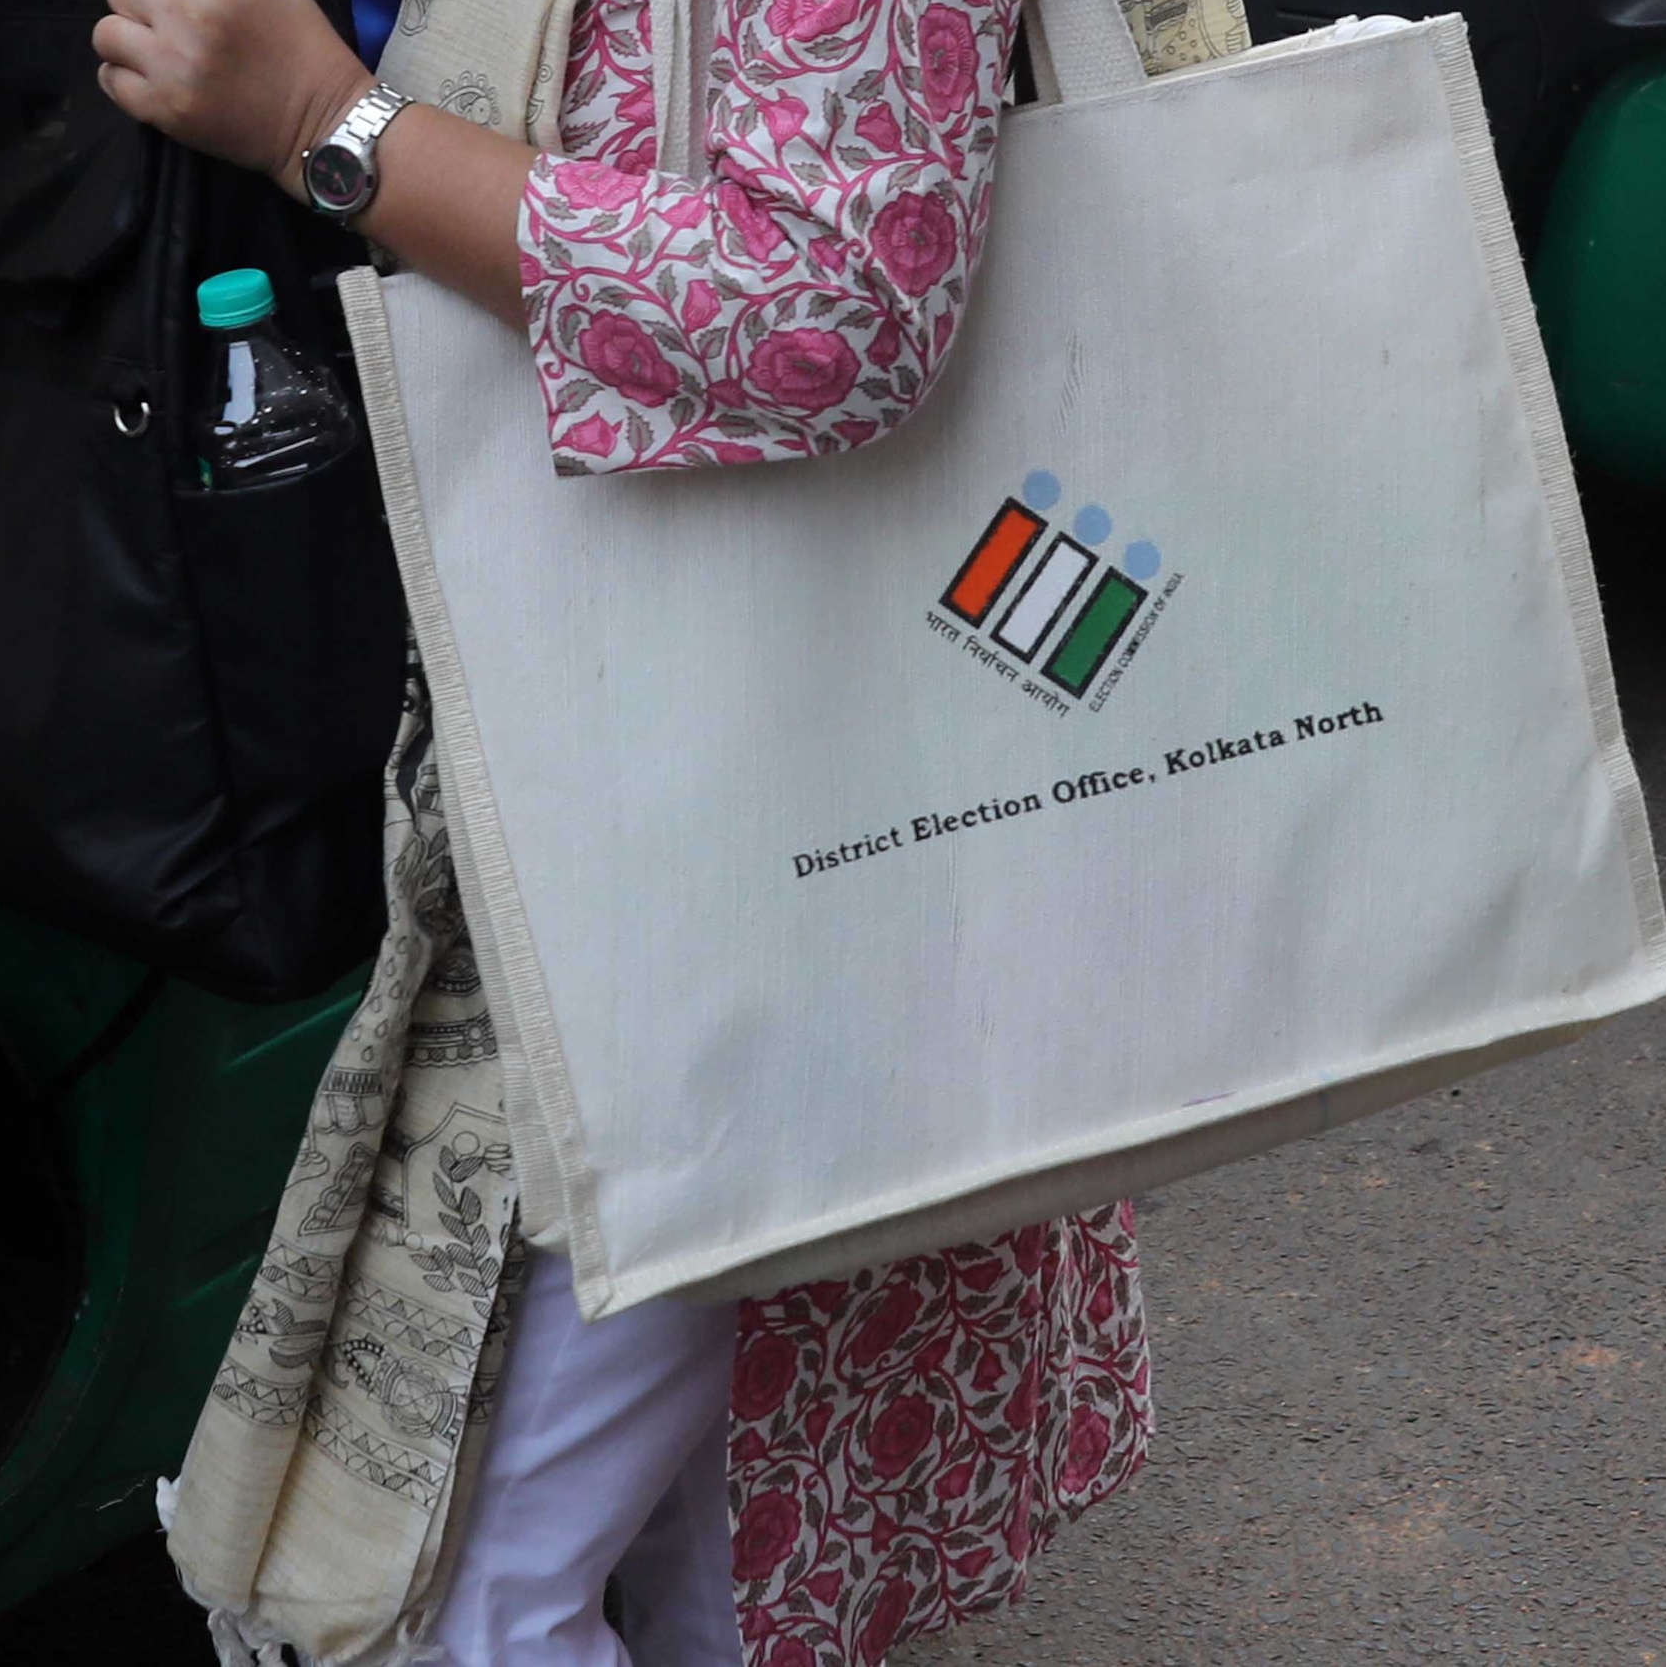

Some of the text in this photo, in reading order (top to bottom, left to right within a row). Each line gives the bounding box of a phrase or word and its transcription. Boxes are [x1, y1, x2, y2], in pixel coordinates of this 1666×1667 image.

[925, 610, 962, 643] भारत
[1021, 679, 1071, 718] आयोग
[1088, 572, 1185, 713] ELECTION COMMISSION OF INDIA
[792, 701, 1384, 878] District Election Office, Kolkata North
